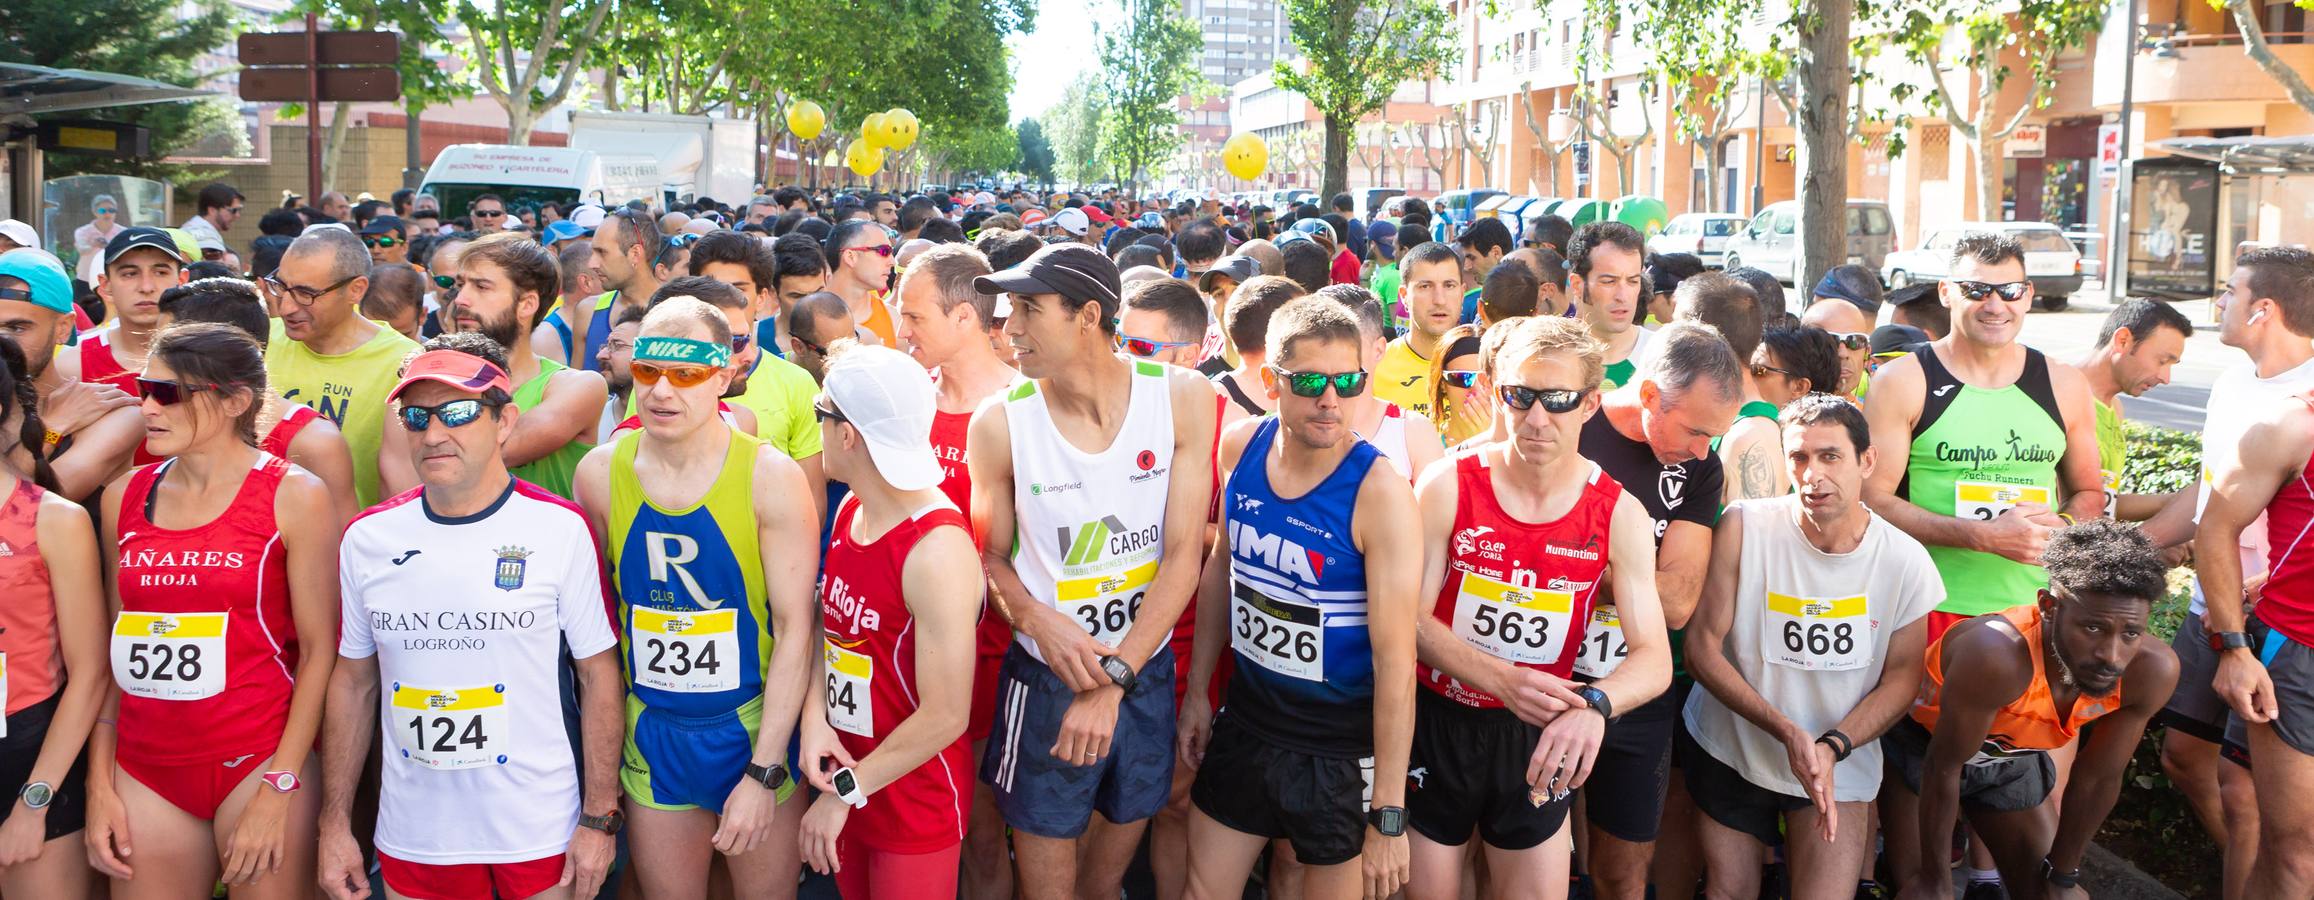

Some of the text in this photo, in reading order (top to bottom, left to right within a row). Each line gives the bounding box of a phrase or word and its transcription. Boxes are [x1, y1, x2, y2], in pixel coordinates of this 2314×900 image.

[646, 341, 697, 358] NIKE
[323, 382, 353, 397] RUN
[1936, 437, 2056, 471] Campo Activo
[1043, 482, 1082, 493] Longfield
[1995, 473, 2034, 486] Runners
[1286, 516, 1324, 536] GSPORT
[1110, 524, 1159, 556] CARGO
[1545, 544, 1599, 561] Numantino
[141, 574, 198, 586] RIOJA
[829, 575, 881, 635] Rioja
[370, 610, 535, 631] GRAN CASINO
[1472, 603, 1549, 649] 563
[404, 636, 485, 650] LOGROÑO
[1237, 605, 1317, 663] 3226
[1783, 620, 1854, 655] 668
[129, 643, 202, 682] 528
[647, 638, 720, 676] 234
[1456, 694, 1480, 708] Soria
[409, 714, 488, 752] 124
